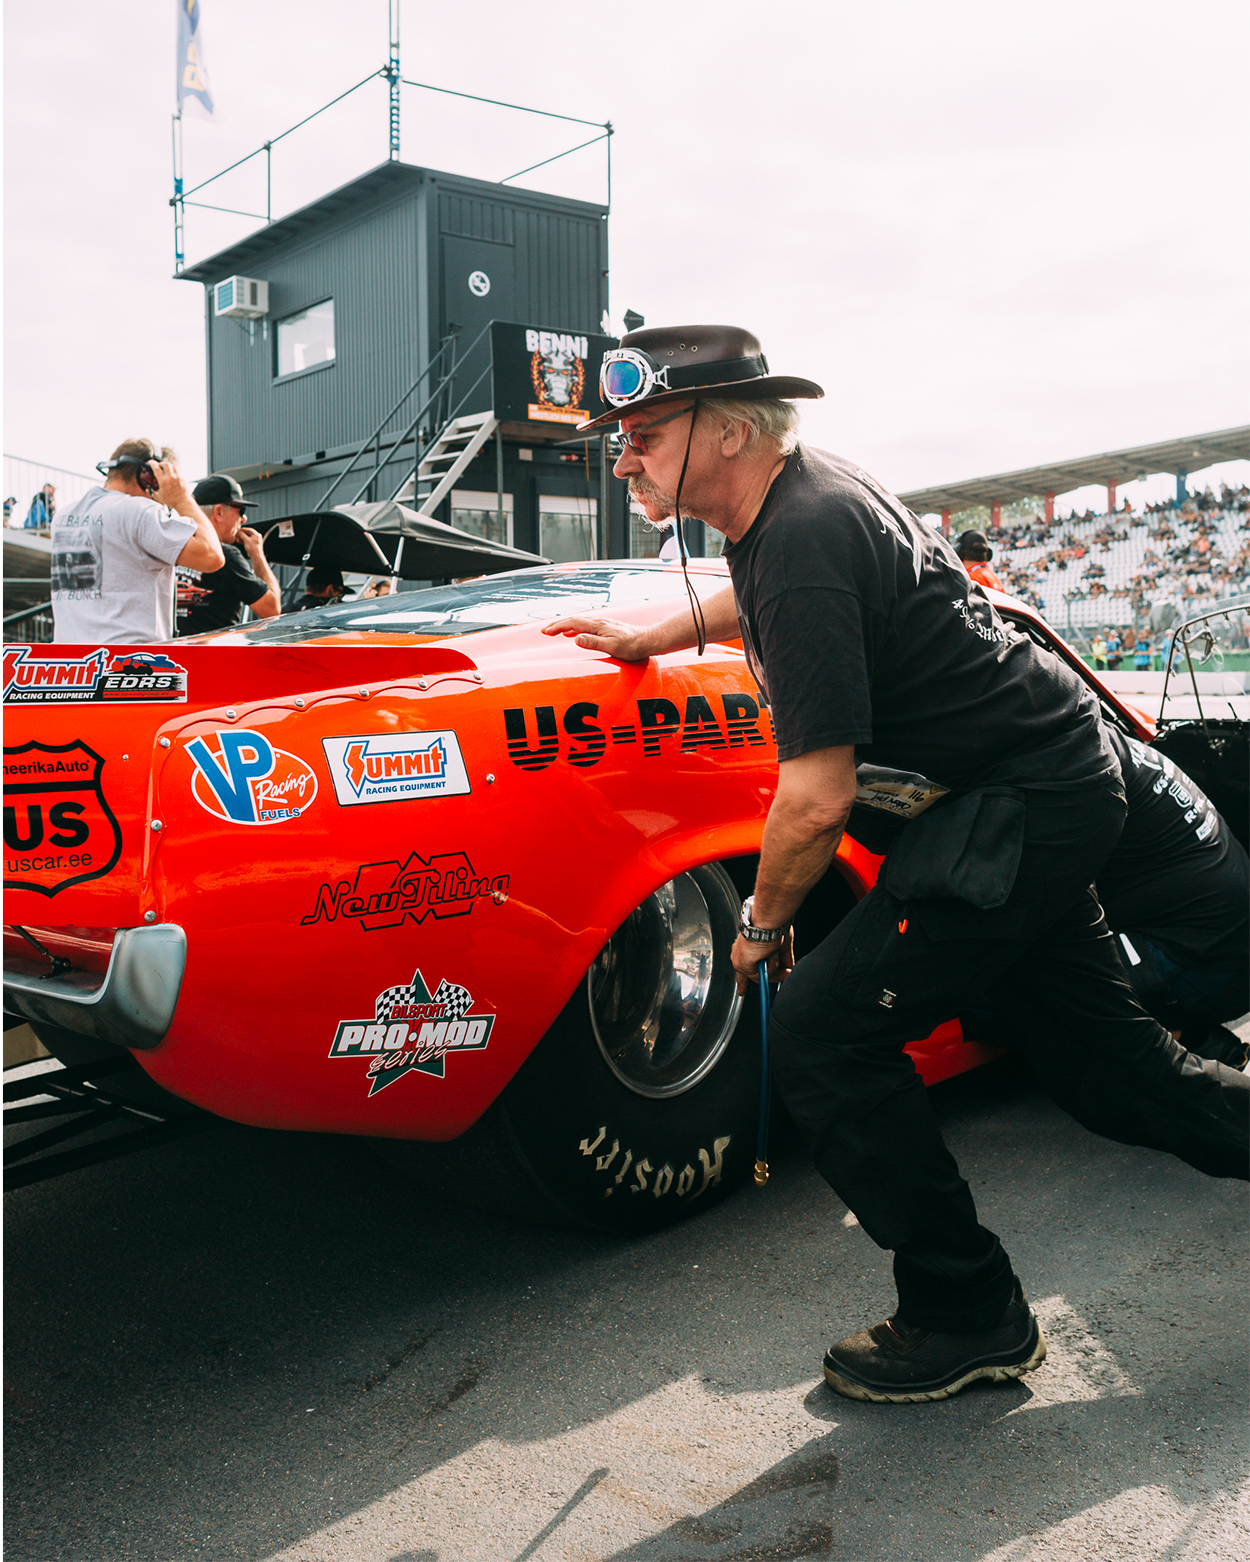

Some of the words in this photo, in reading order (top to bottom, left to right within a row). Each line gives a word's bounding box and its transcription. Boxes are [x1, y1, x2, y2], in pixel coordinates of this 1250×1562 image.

[525, 329, 589, 360] BENNI
[104, 677, 172, 689] EDRS
[9, 692, 43, 700] RACING
[45, 692, 95, 700] EQUIPMENT
[185, 730, 276, 822] VP
[255, 772, 314, 809] Racing
[365, 784, 398, 795] RACING
[399, 781, 446, 792] EQUIPMENT
[260, 808, 301, 820] FUELS
[3, 801, 90, 852] US
[7, 853, 92, 873] uscar.ee
[390, 1003, 448, 1019] BILSPORT
[369, 1040, 452, 1073] series
